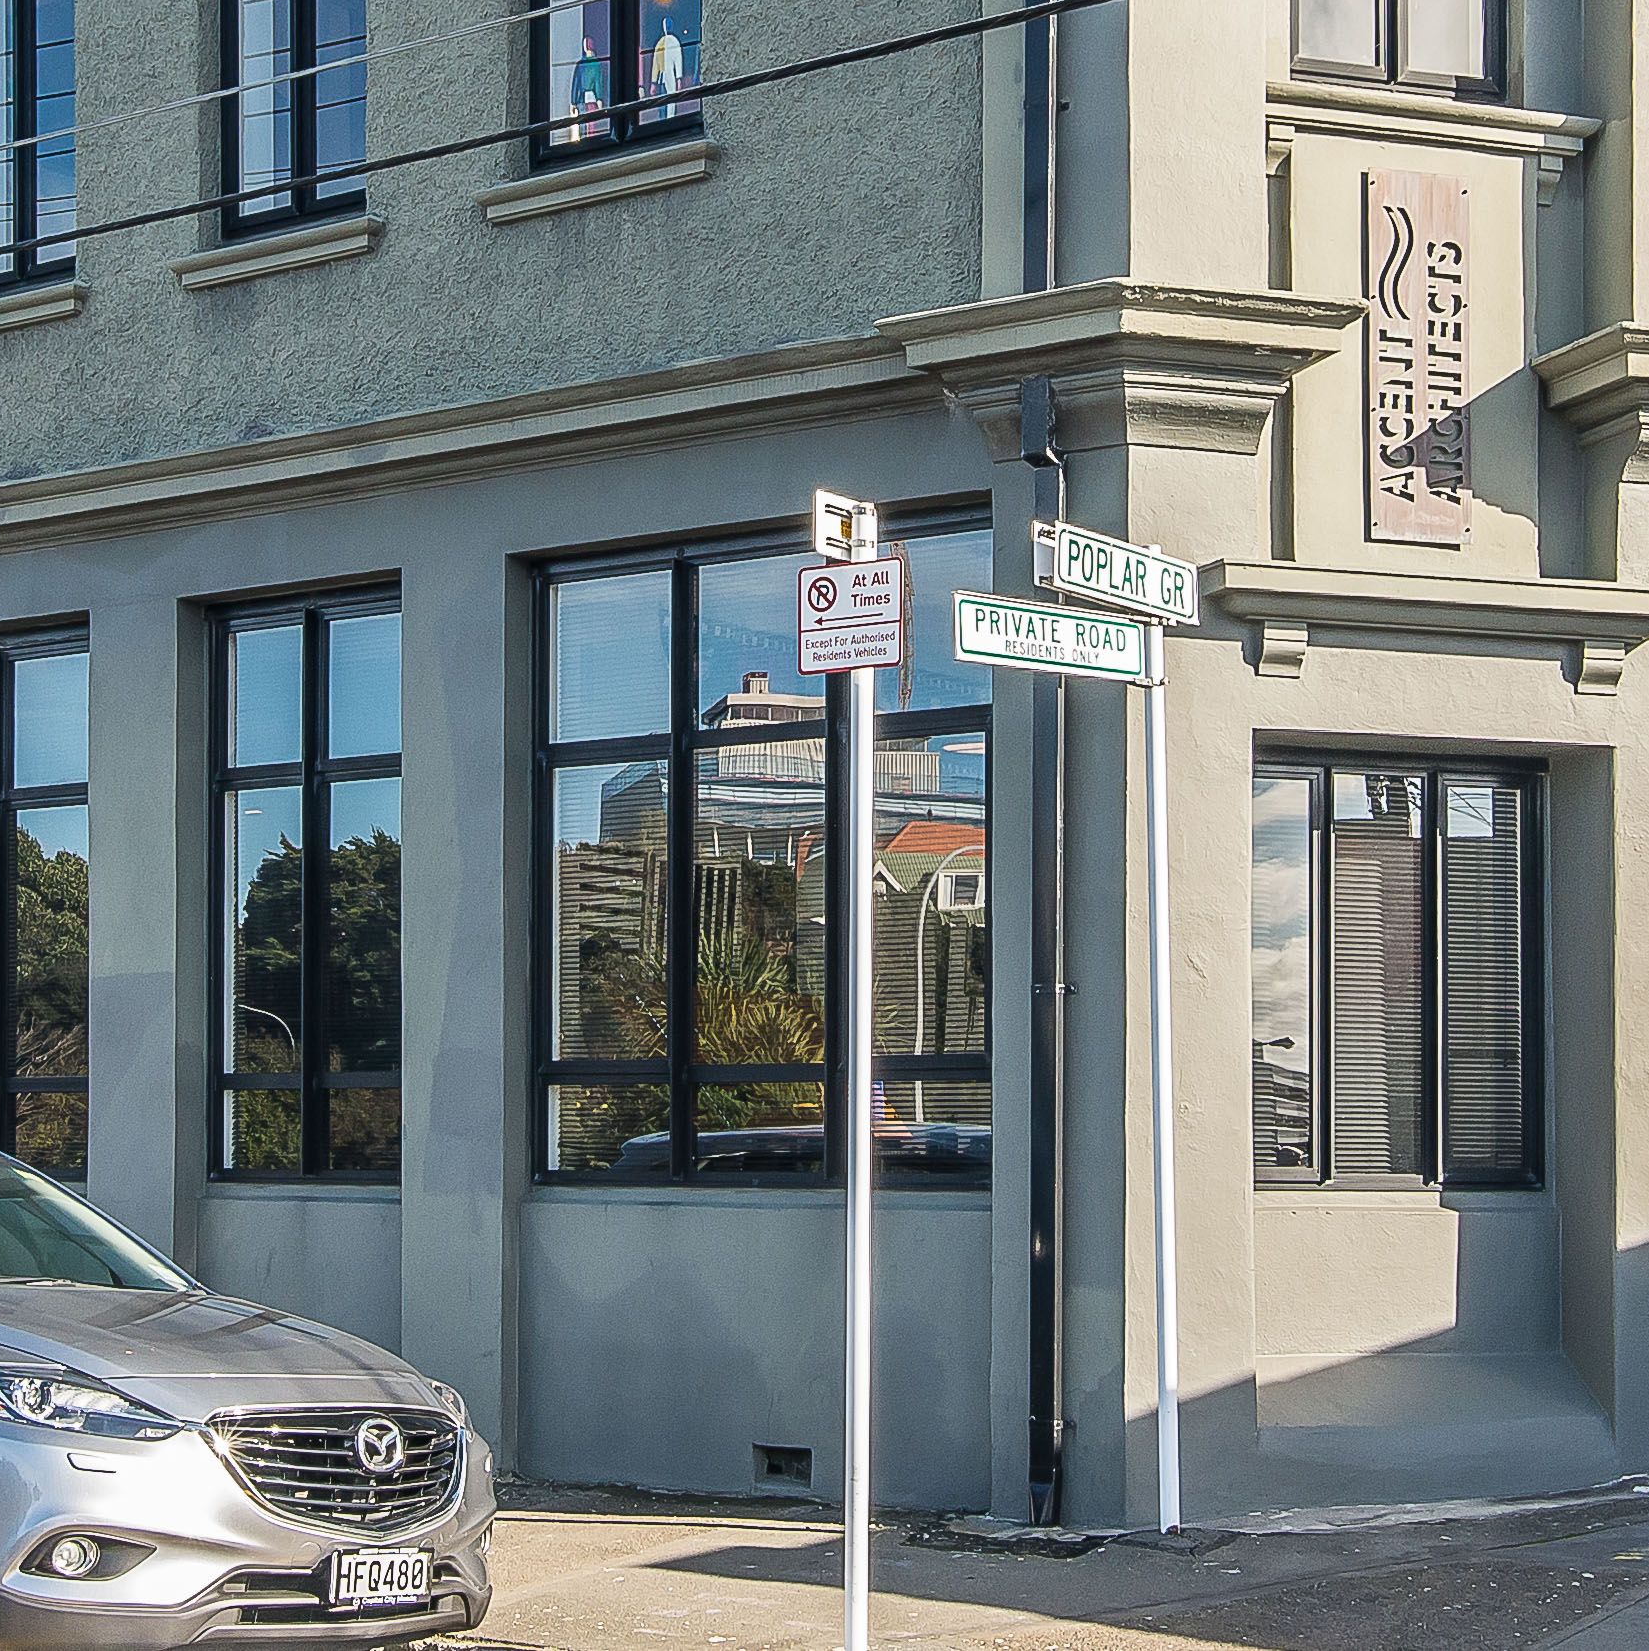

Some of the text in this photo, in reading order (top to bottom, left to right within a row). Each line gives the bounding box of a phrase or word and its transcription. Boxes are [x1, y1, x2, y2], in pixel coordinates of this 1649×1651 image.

[1427, 241, 1465, 506] ARCHITECTS
[1378, 328, 1415, 503] ACCENT
[852, 570, 890, 589] At All
[1068, 538, 1185, 610] POPLAR GR
[851, 593, 891, 608] Times
[805, 630, 896, 650] Except For Authorised
[975, 608, 1127, 652] PRIVATE ROAD
[812, 645, 888, 662] Residents Vehicles
[1005, 639, 1100, 664] RESIDENTS ONLY
[337, 1558, 425, 1593] HFQ480
